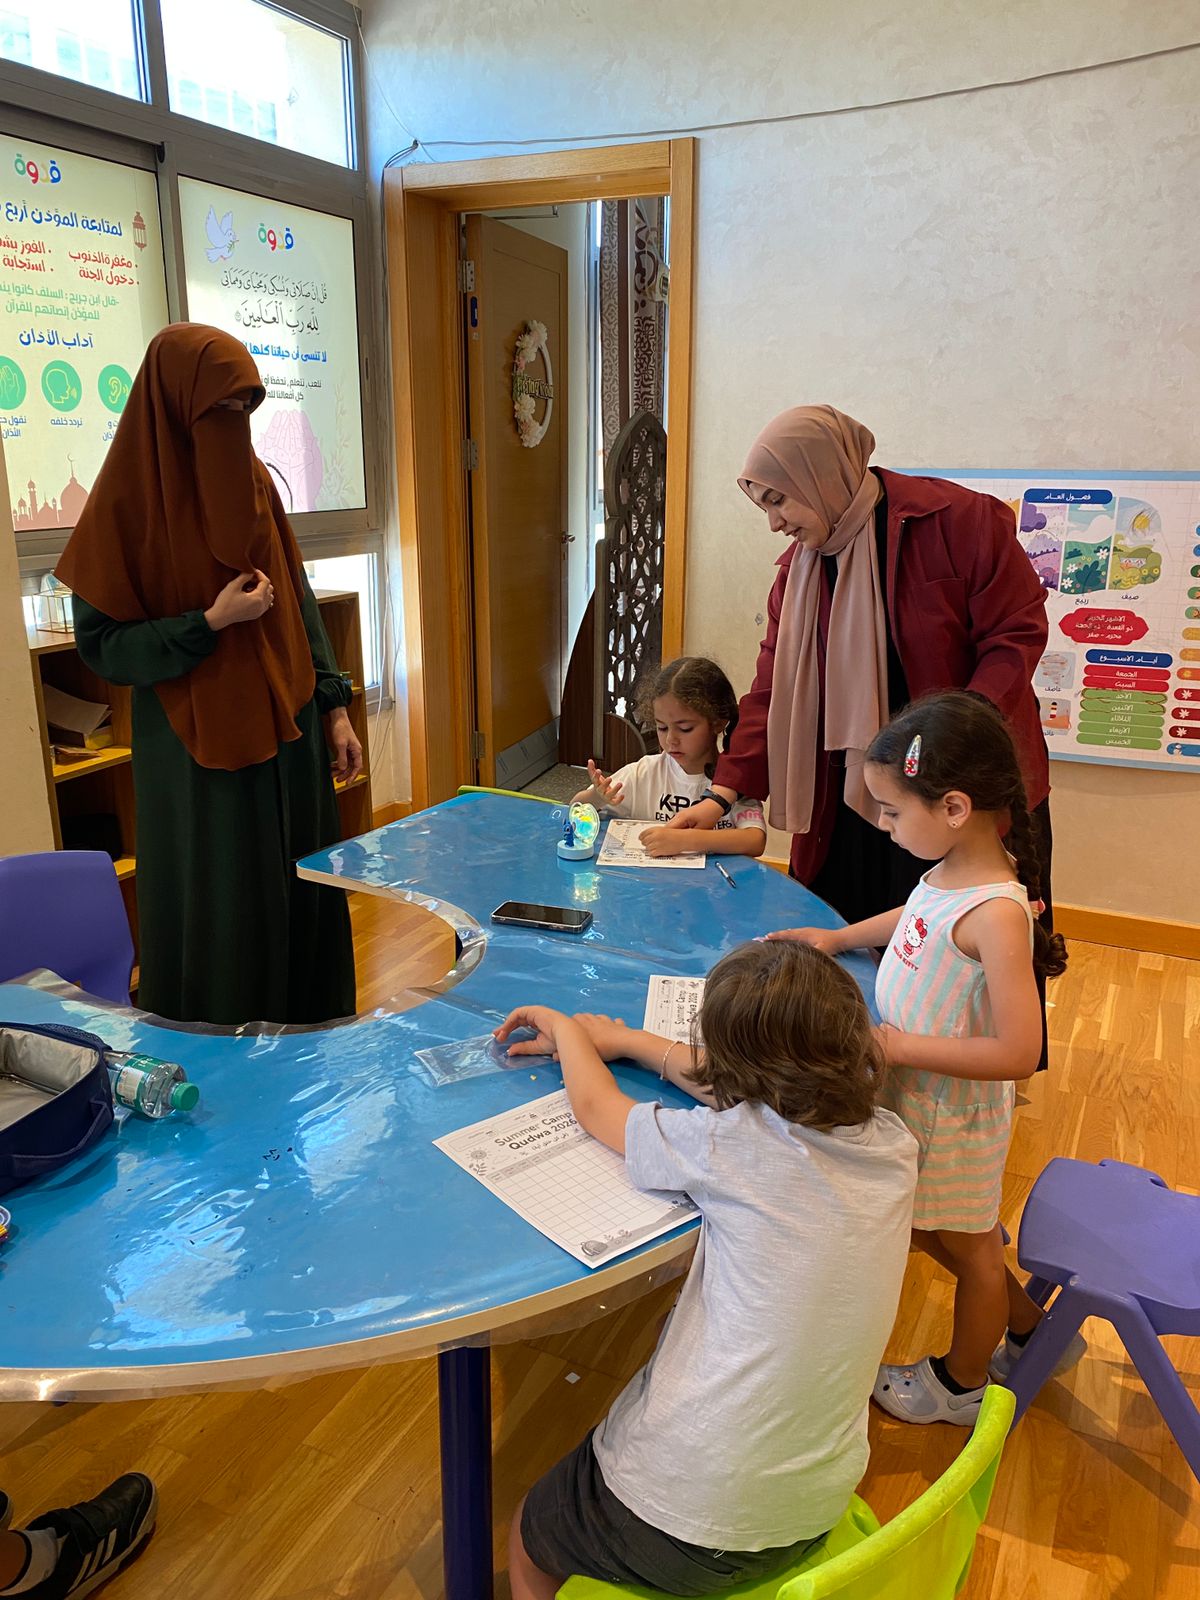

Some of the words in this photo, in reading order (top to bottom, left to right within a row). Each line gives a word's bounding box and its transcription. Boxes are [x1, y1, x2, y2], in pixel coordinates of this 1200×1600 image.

[5, 200, 28, 222] أربع
[31, 208, 78, 227] المؤذن
[81, 216, 122, 236] لمتابعة
[21, 240, 45, 254] الفوز
[3, 254, 45, 272] استجابة
[79, 266, 104, 281] الجنة
[106, 271, 134, 285] دخول
[36, 286, 63, 298] السلف
[19, 328, 60, 346] الأذان
[62, 332, 93, 349] آداب
[494, 1123, 540, 1146] Summer
[541, 1112, 573, 1126] Camp
[508, 1129, 551, 1150] Qudwa
[551, 1119, 578, 1132] 2026
